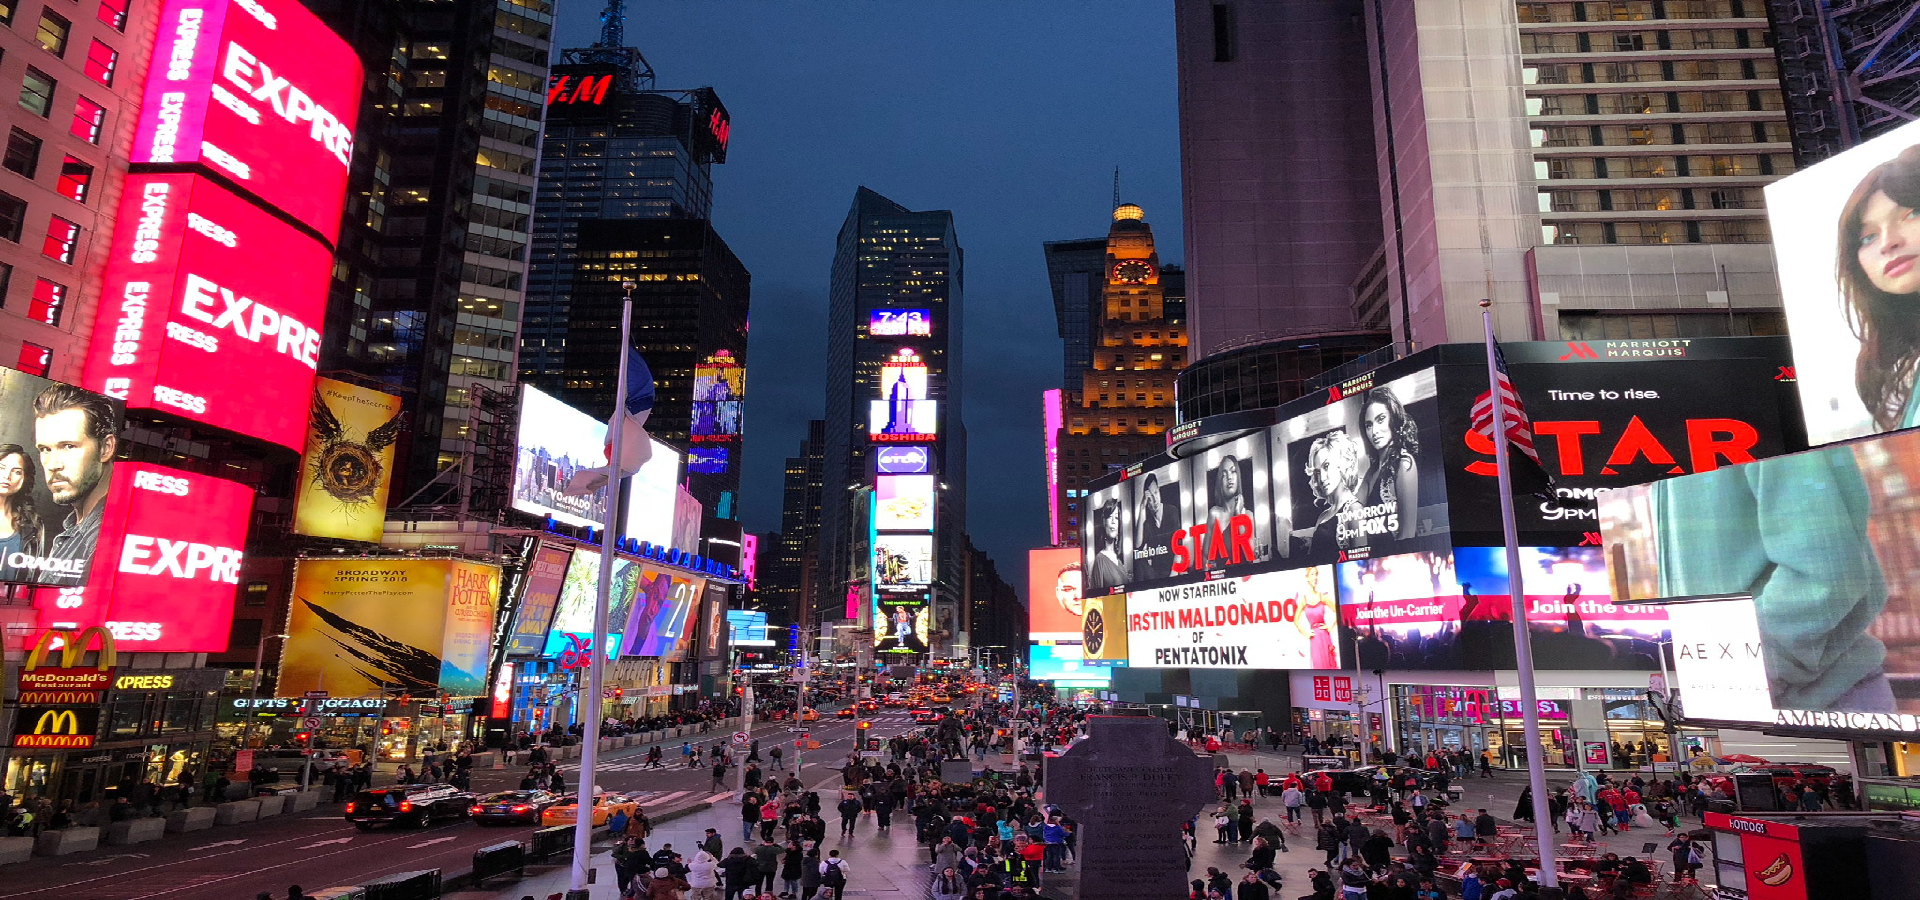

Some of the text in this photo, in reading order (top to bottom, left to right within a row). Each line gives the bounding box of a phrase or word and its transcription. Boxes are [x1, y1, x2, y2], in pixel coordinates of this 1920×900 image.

[166, 8, 203, 80] EXPRESS
[149, 92, 185, 162] EXPRESS
[131, 183, 169, 263] EXPRESS
[111, 282, 150, 366] EXPRESS
[879, 312, 921, 325] 7:43
[1606, 340, 1691, 348] MARRIOTT
[1607, 349, 1683, 357] MARQUIS
[1342, 371, 1375, 389] MARRIOTT
[1342, 380, 1373, 397] MARQUIS
[326, 389, 393, 410] #KeepTheSecrets
[1548, 389, 1661, 401] Time to rise.
[870, 433, 936, 441] TOSHIBA
[1172, 421, 1202, 435] MARRIOTT
[1172, 429, 1198, 442] MARQUIS
[1464, 415, 1759, 476] STAR
[134, 470, 189, 496] RESS
[1336, 502, 1398, 522] TOMORROW
[1336, 513, 1399, 541] 9PM FOX 5
[586, 525, 732, 579] 140 BROADWAY
[1133, 549, 1149, 560] Time
[1156, 544, 1168, 556] rise.
[1171, 513, 1256, 574] STAR
[119, 533, 243, 585] EXPRE
[457, 568, 494, 589] HARRY
[451, 585, 493, 607] POTTER
[504, 573, 521, 608] MAC
[1158, 581, 1237, 603] NOW STARRING
[664, 583, 696, 639] 21
[1127, 598, 1298, 632] IRSTIN MALDONADO
[1356, 602, 1444, 619] Join the Un-Carrier
[1530, 600, 1670, 614] Join the Un-
[493, 610, 510, 646] MAC
[1192, 631, 1204, 644] OF
[1155, 645, 1248, 666] PENTATONIX
[1680, 643, 1708, 660] AE
[1718, 643, 1734, 660] X
[21, 674, 108, 682] McDonald's
[1335, 679, 1349, 689] UNI
[233, 698, 288, 708] GIFTS
[1776, 710, 1902, 731] AMERICAN
[82, 755, 113, 763] EXPRESS
[1080, 773, 1127, 781] FRANCIS
[1143, 773, 1180, 781] DUFFY
